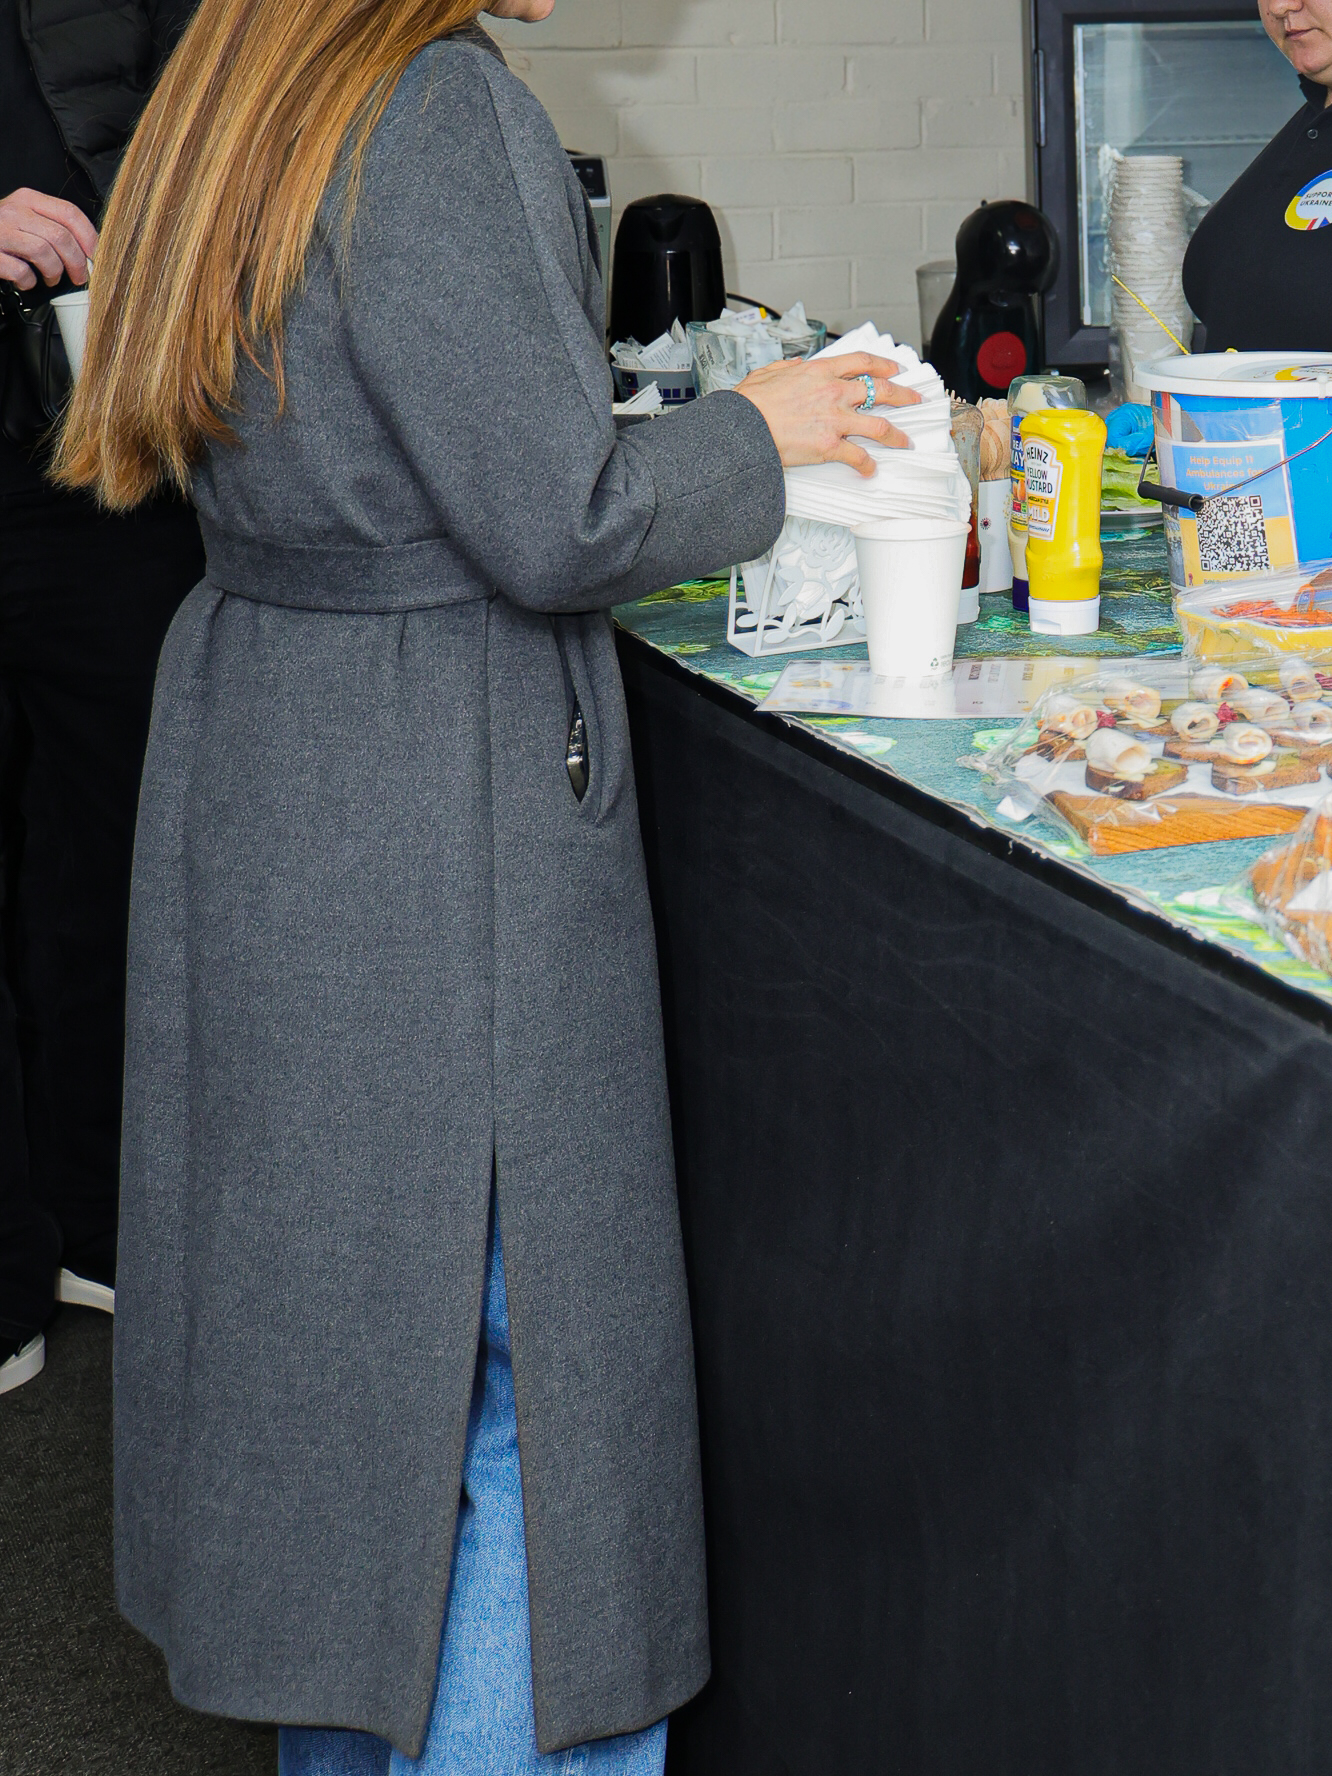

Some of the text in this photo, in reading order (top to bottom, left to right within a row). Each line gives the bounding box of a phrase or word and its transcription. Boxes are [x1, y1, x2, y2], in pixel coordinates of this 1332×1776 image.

[1026, 446, 1049, 464] HEINZ
[1190, 455, 1210, 466] Help
[1213, 455, 1242, 466] Equip
[1026, 467, 1048, 481] YELLOW
[1186, 467, 1245, 478] Ambulances
